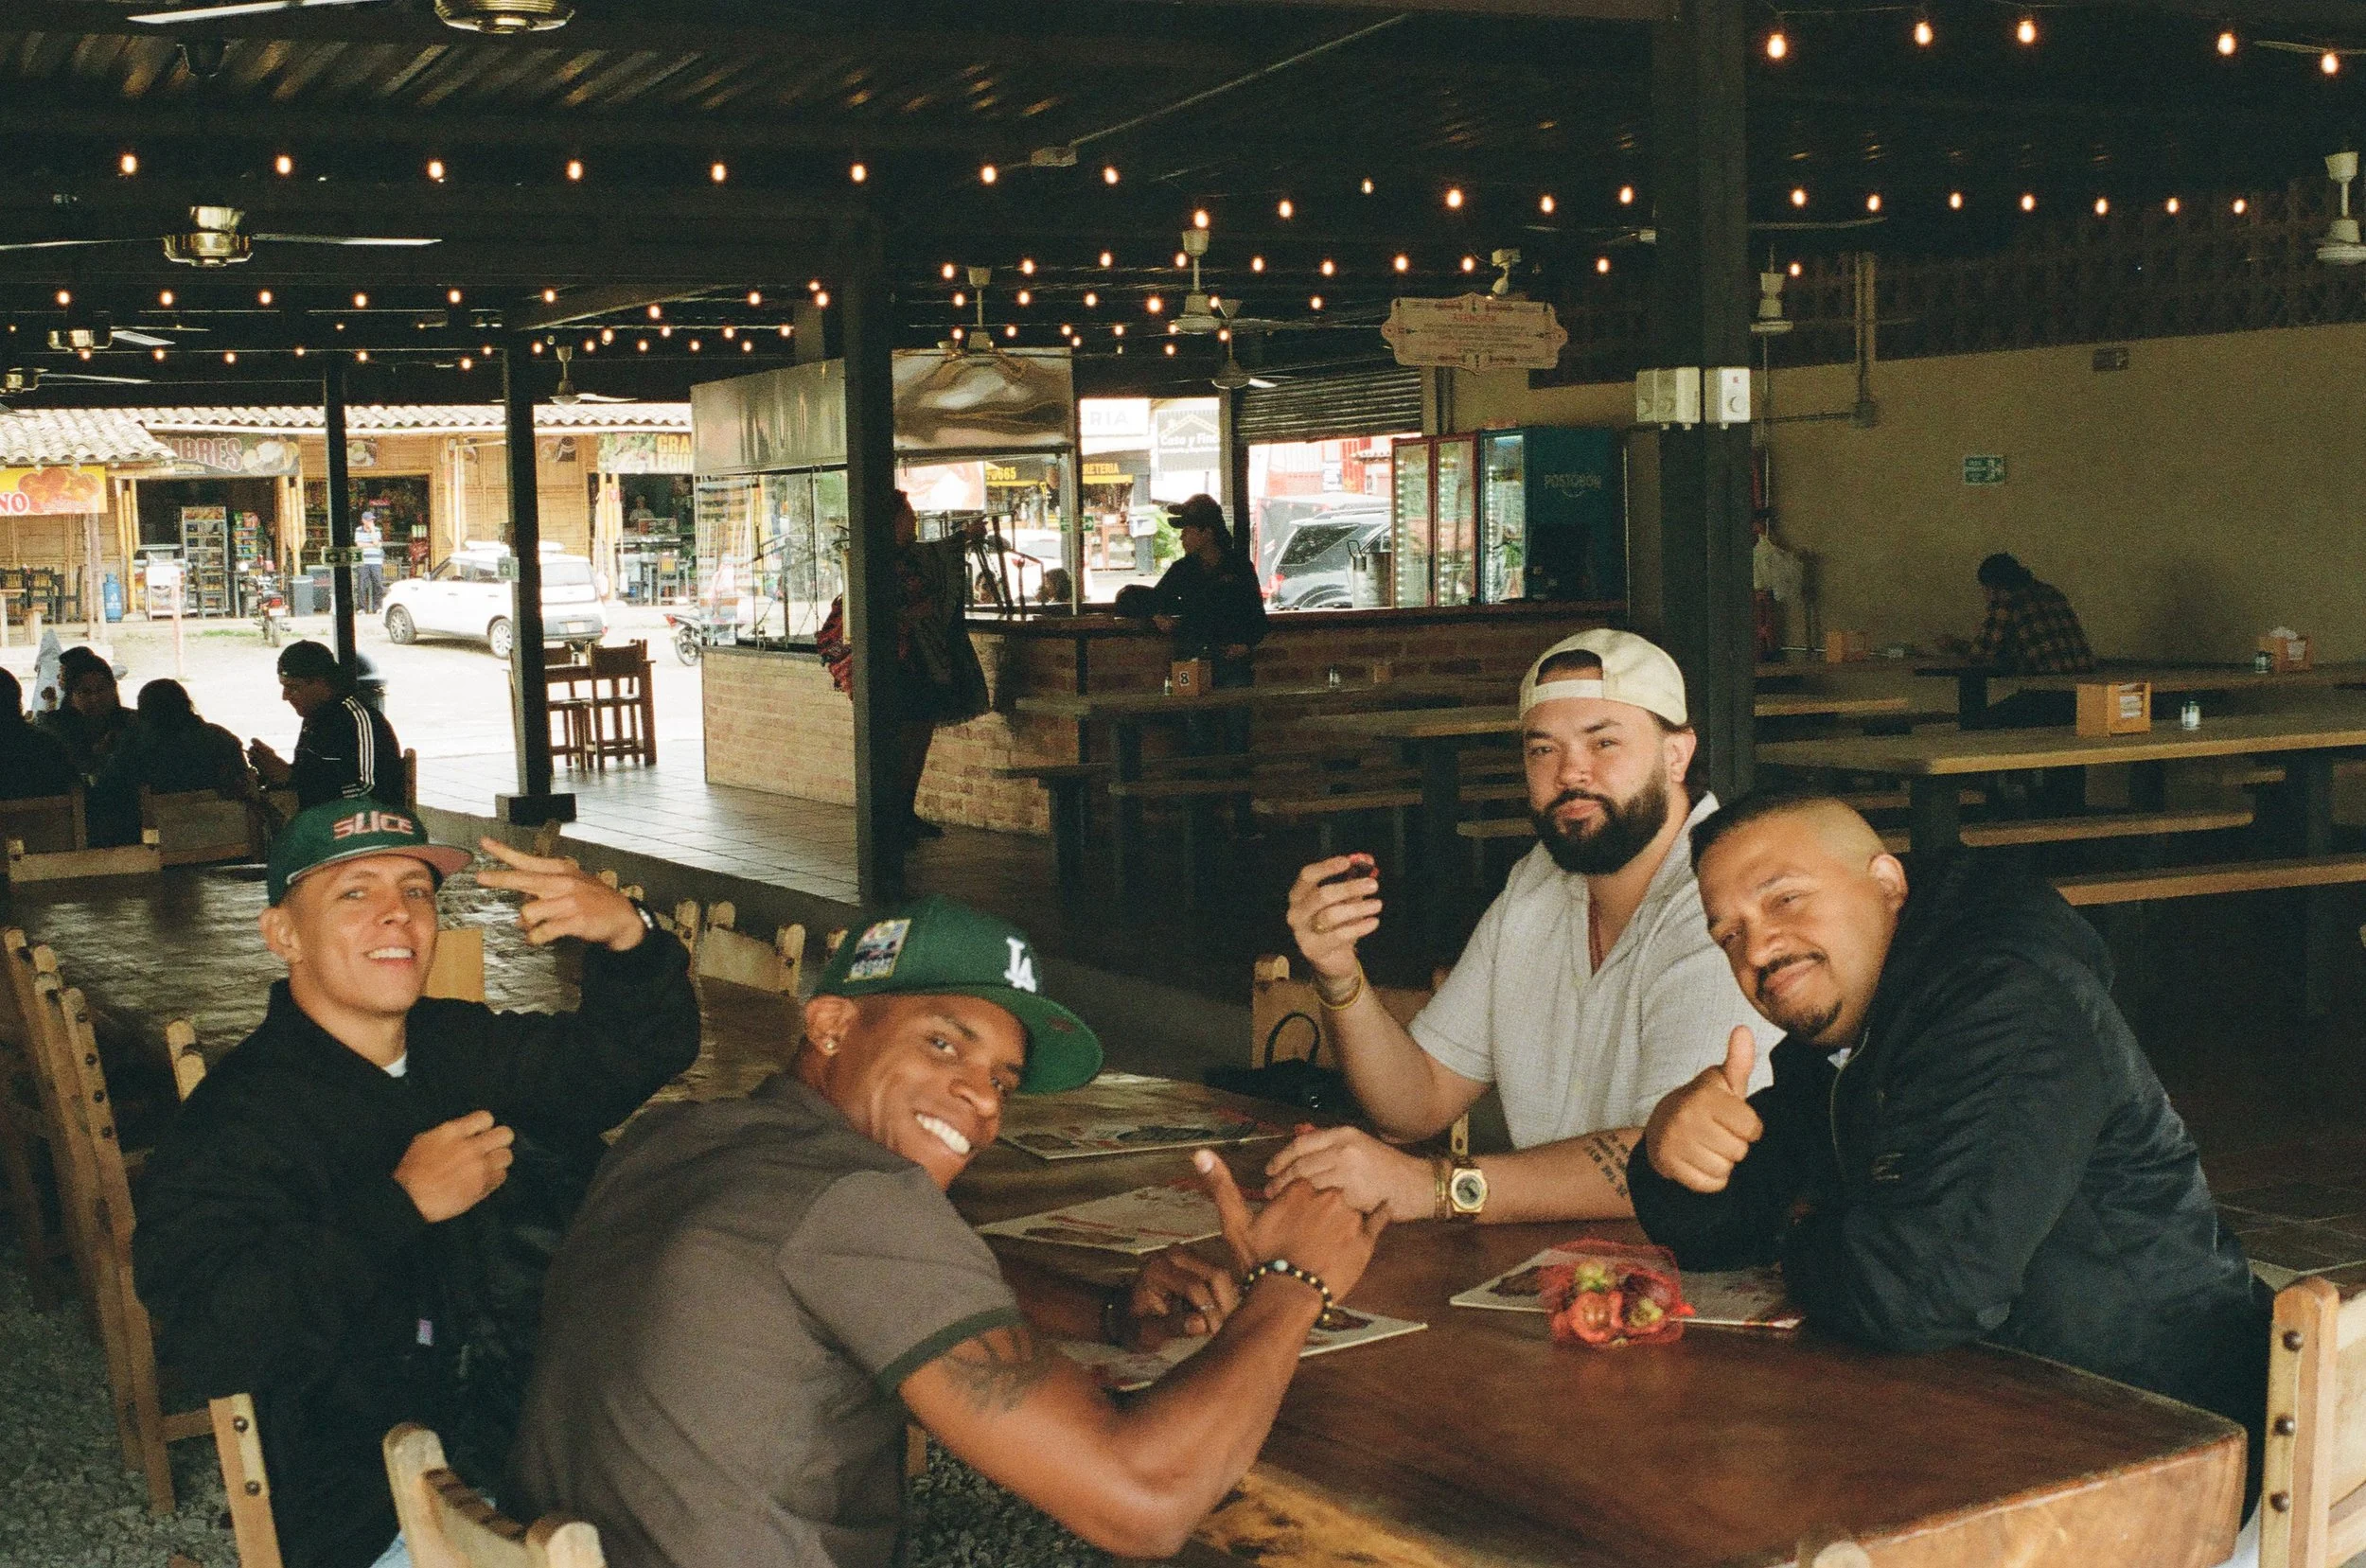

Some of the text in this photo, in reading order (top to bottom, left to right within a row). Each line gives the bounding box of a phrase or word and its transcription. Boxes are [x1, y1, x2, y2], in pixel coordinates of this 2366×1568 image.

[1180, 673, 1189, 684] 8
[332, 810, 414, 839] SLICE
[1003, 936, 1036, 993] LA
